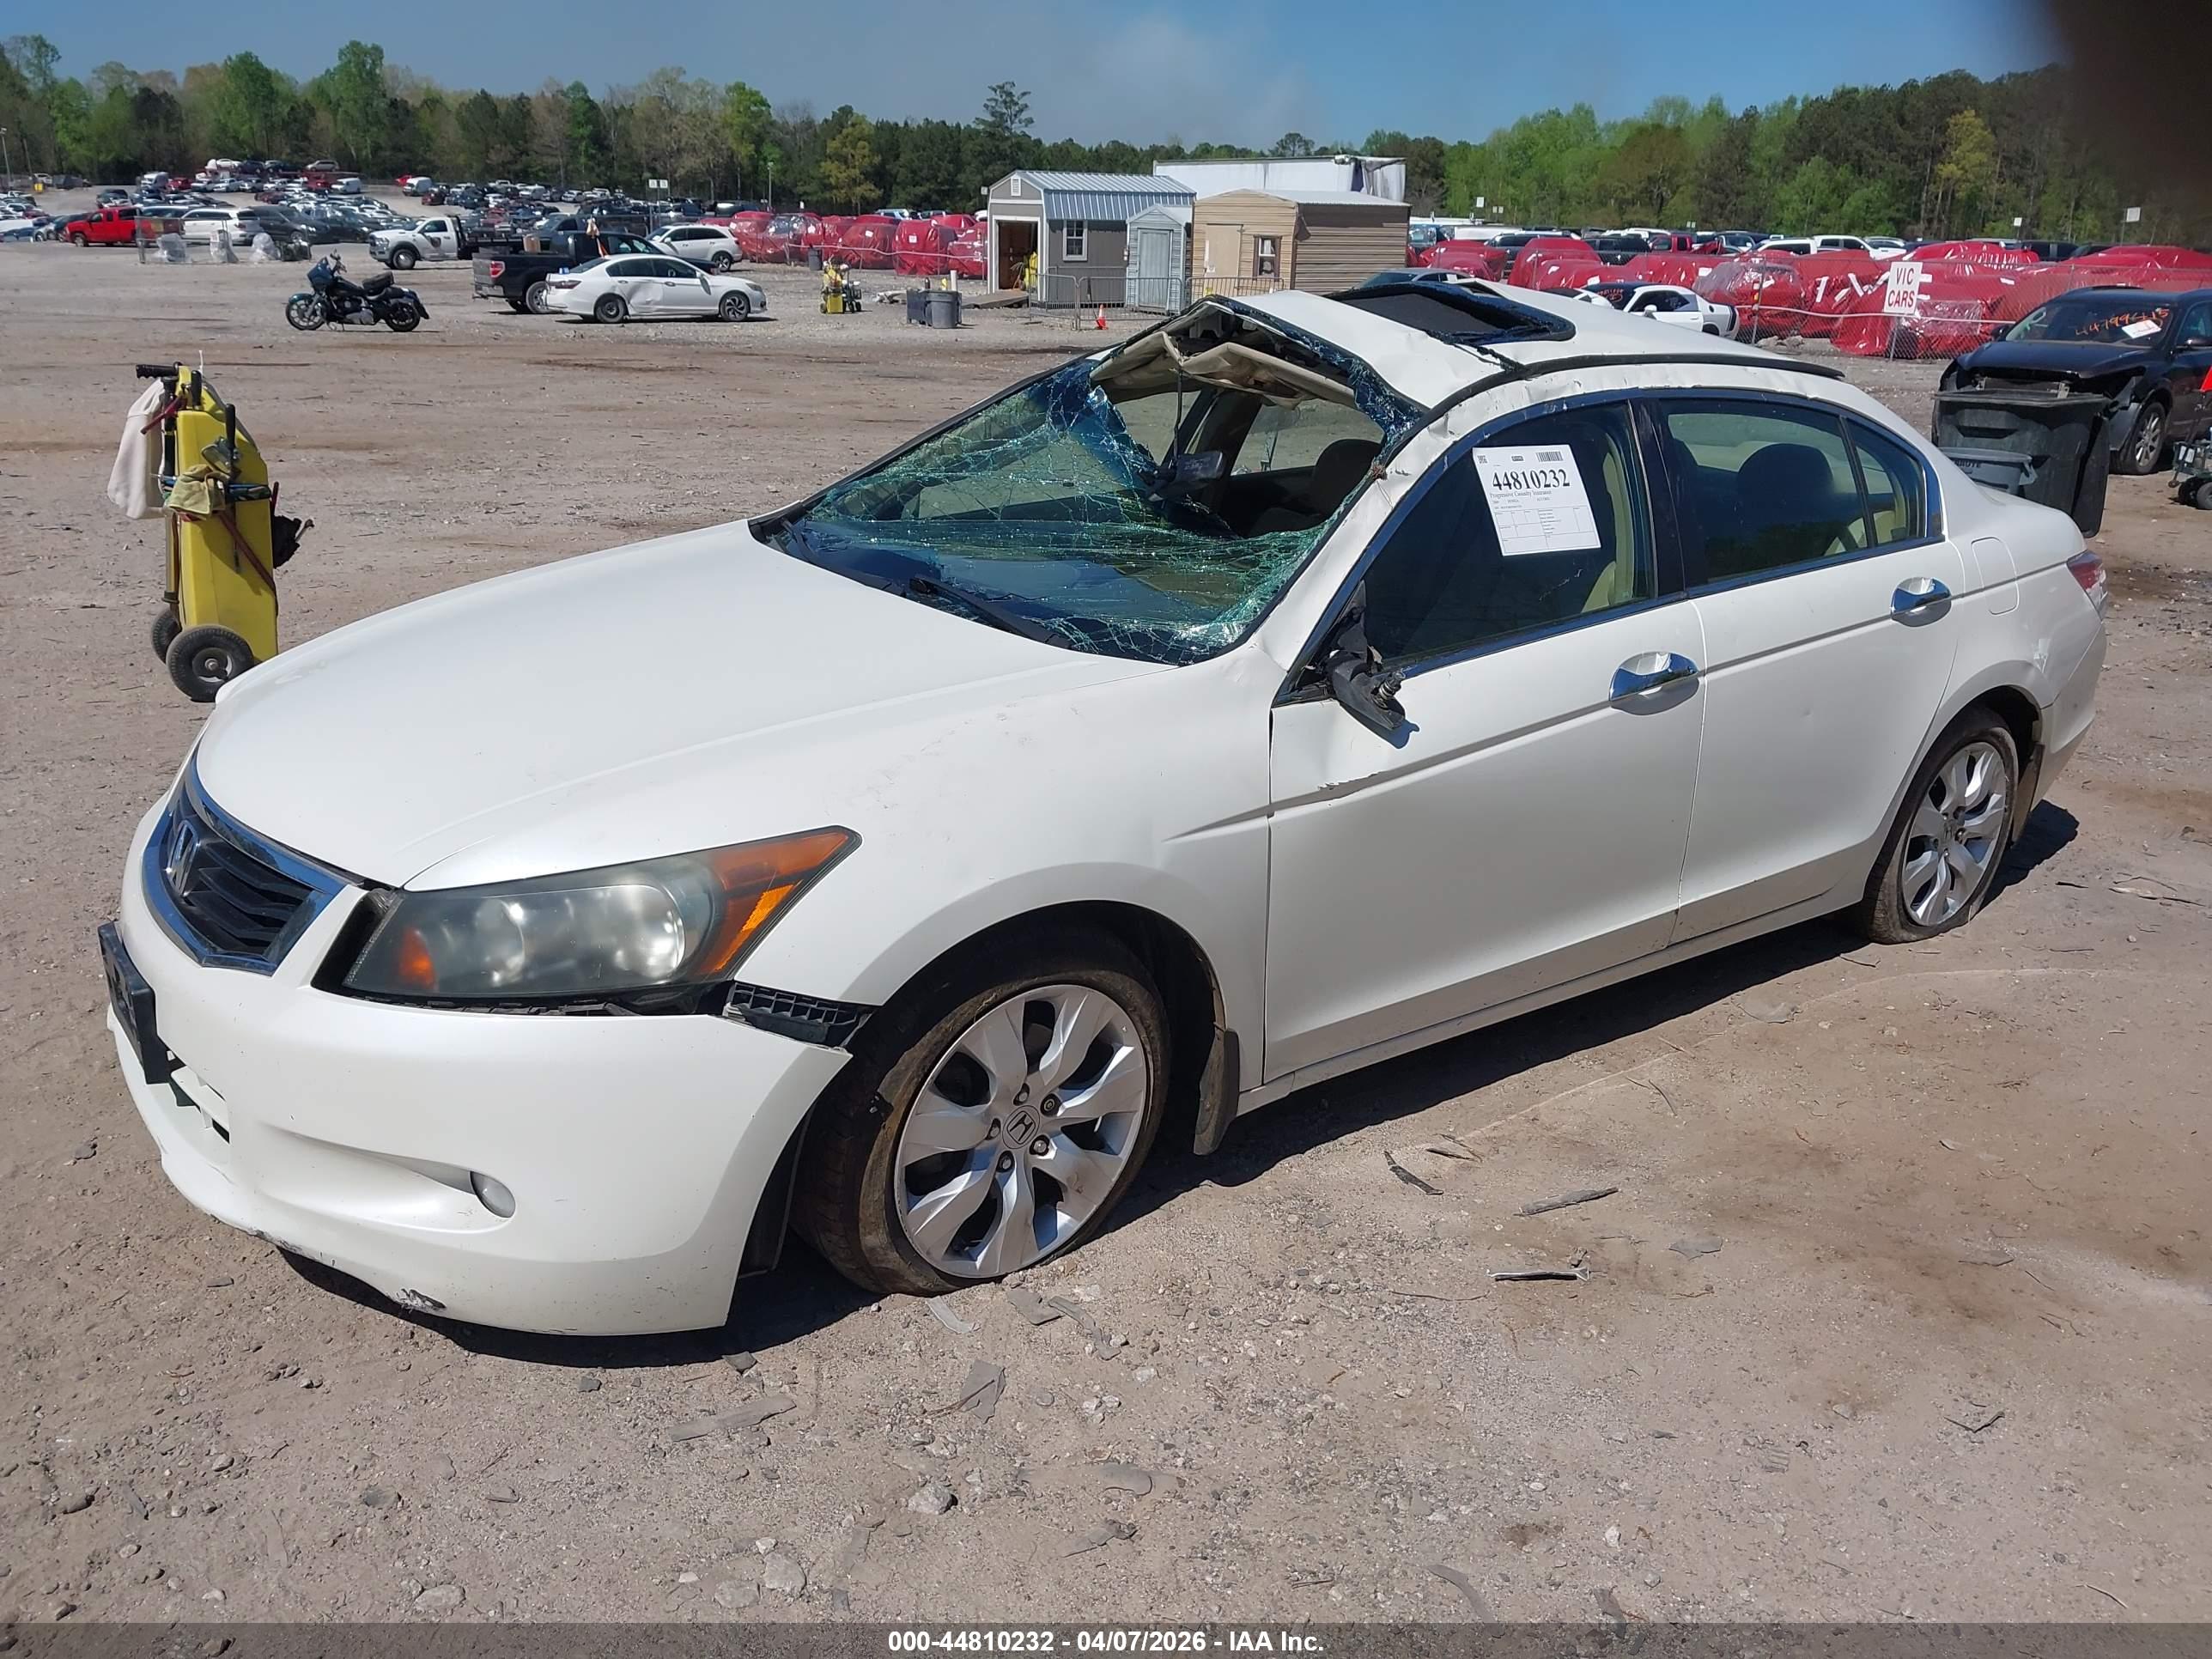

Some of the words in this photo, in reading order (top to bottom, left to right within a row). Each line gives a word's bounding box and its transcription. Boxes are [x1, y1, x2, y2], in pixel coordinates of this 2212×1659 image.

[1896, 267, 1915, 285] VIC
[1887, 289, 1915, 307] CARS
[1492, 469, 1571, 490] 44810232
